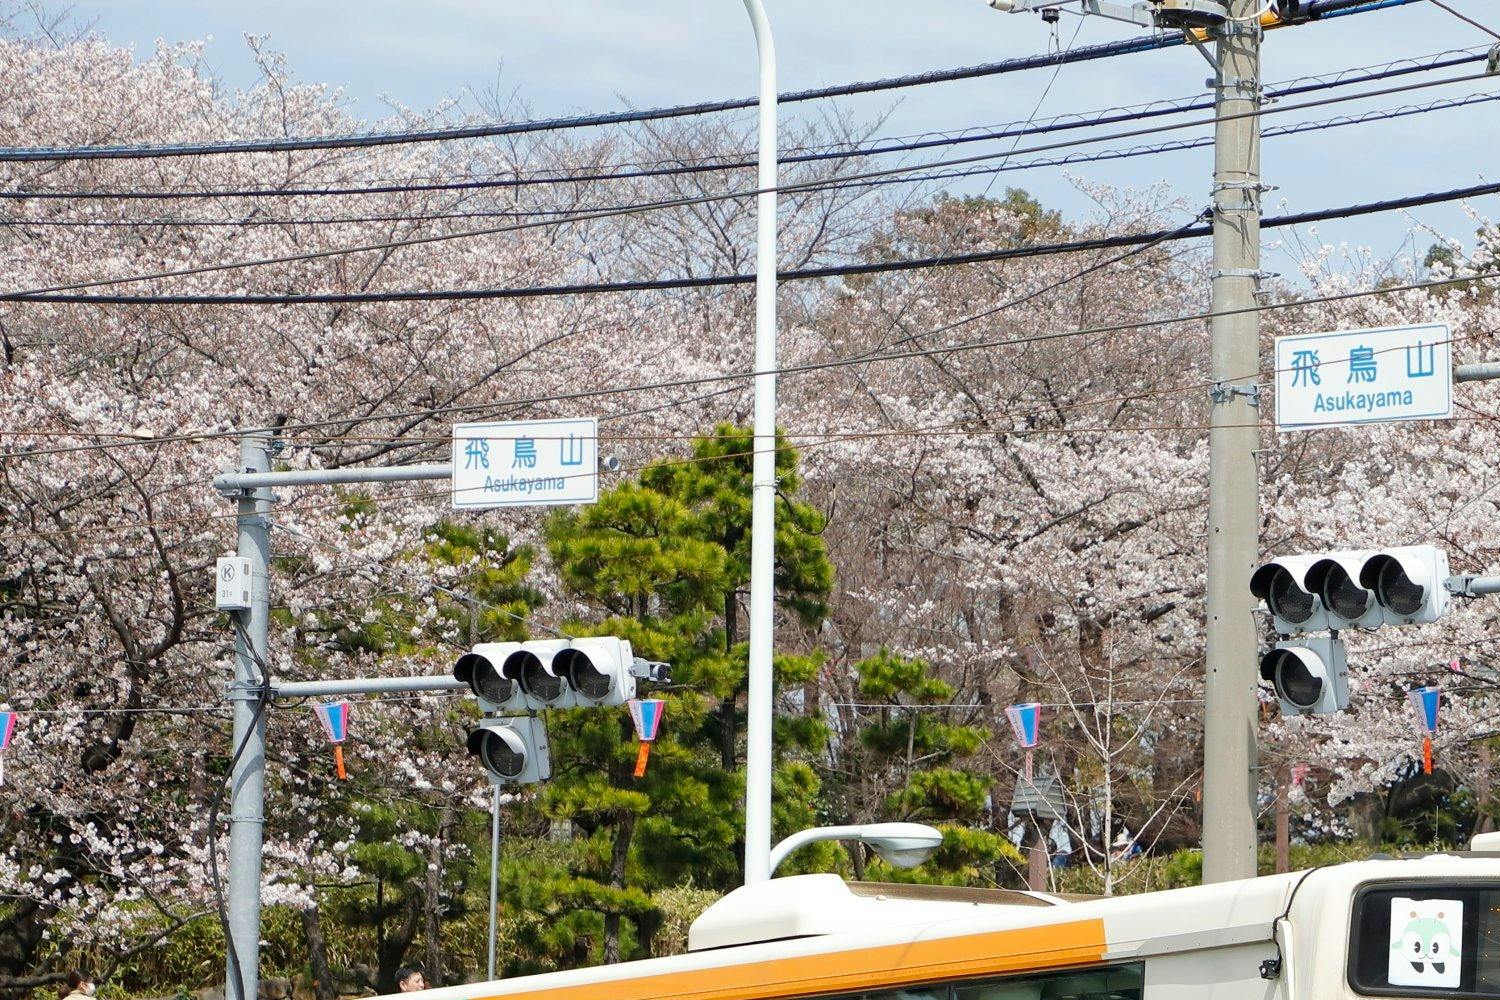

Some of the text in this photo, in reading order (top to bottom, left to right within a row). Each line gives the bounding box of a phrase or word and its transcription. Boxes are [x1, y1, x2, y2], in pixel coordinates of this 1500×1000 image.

[1290, 340, 1435, 388] 飛鳥山
[1313, 389, 1413, 413] Asukayama
[464, 432, 583, 470] 飛鳥山
[483, 475, 565, 495] Asukayama
